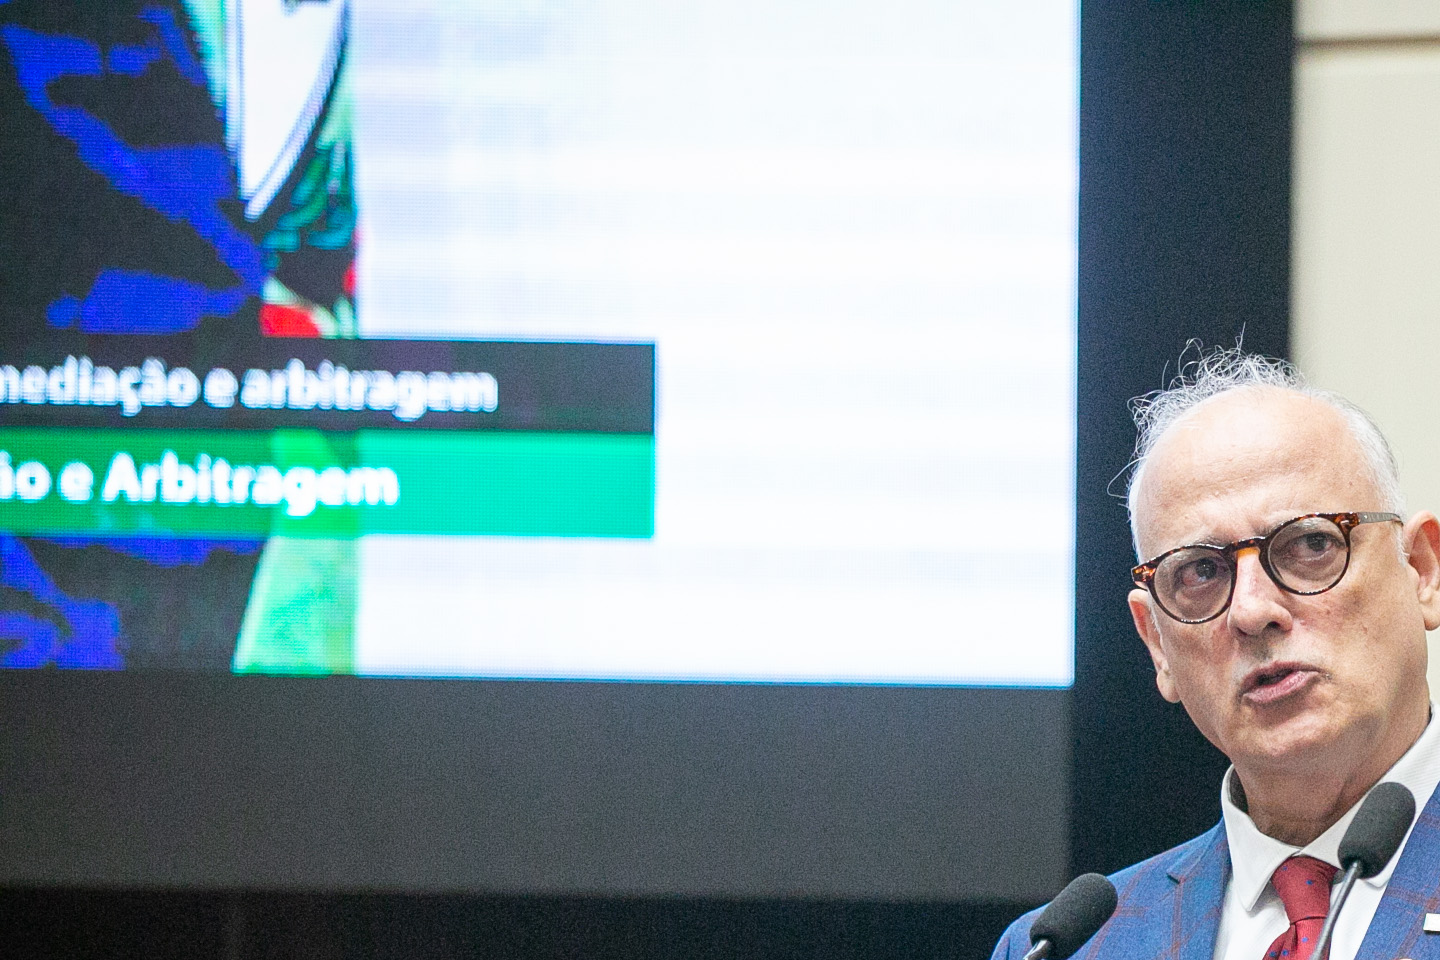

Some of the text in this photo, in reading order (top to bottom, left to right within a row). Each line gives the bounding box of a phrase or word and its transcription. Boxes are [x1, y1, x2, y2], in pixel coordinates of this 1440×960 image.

[203, 367, 238, 408] e
[240, 358, 499, 421] arbitragem
[57, 460, 95, 505] e
[101, 449, 399, 517] Arbitragem
